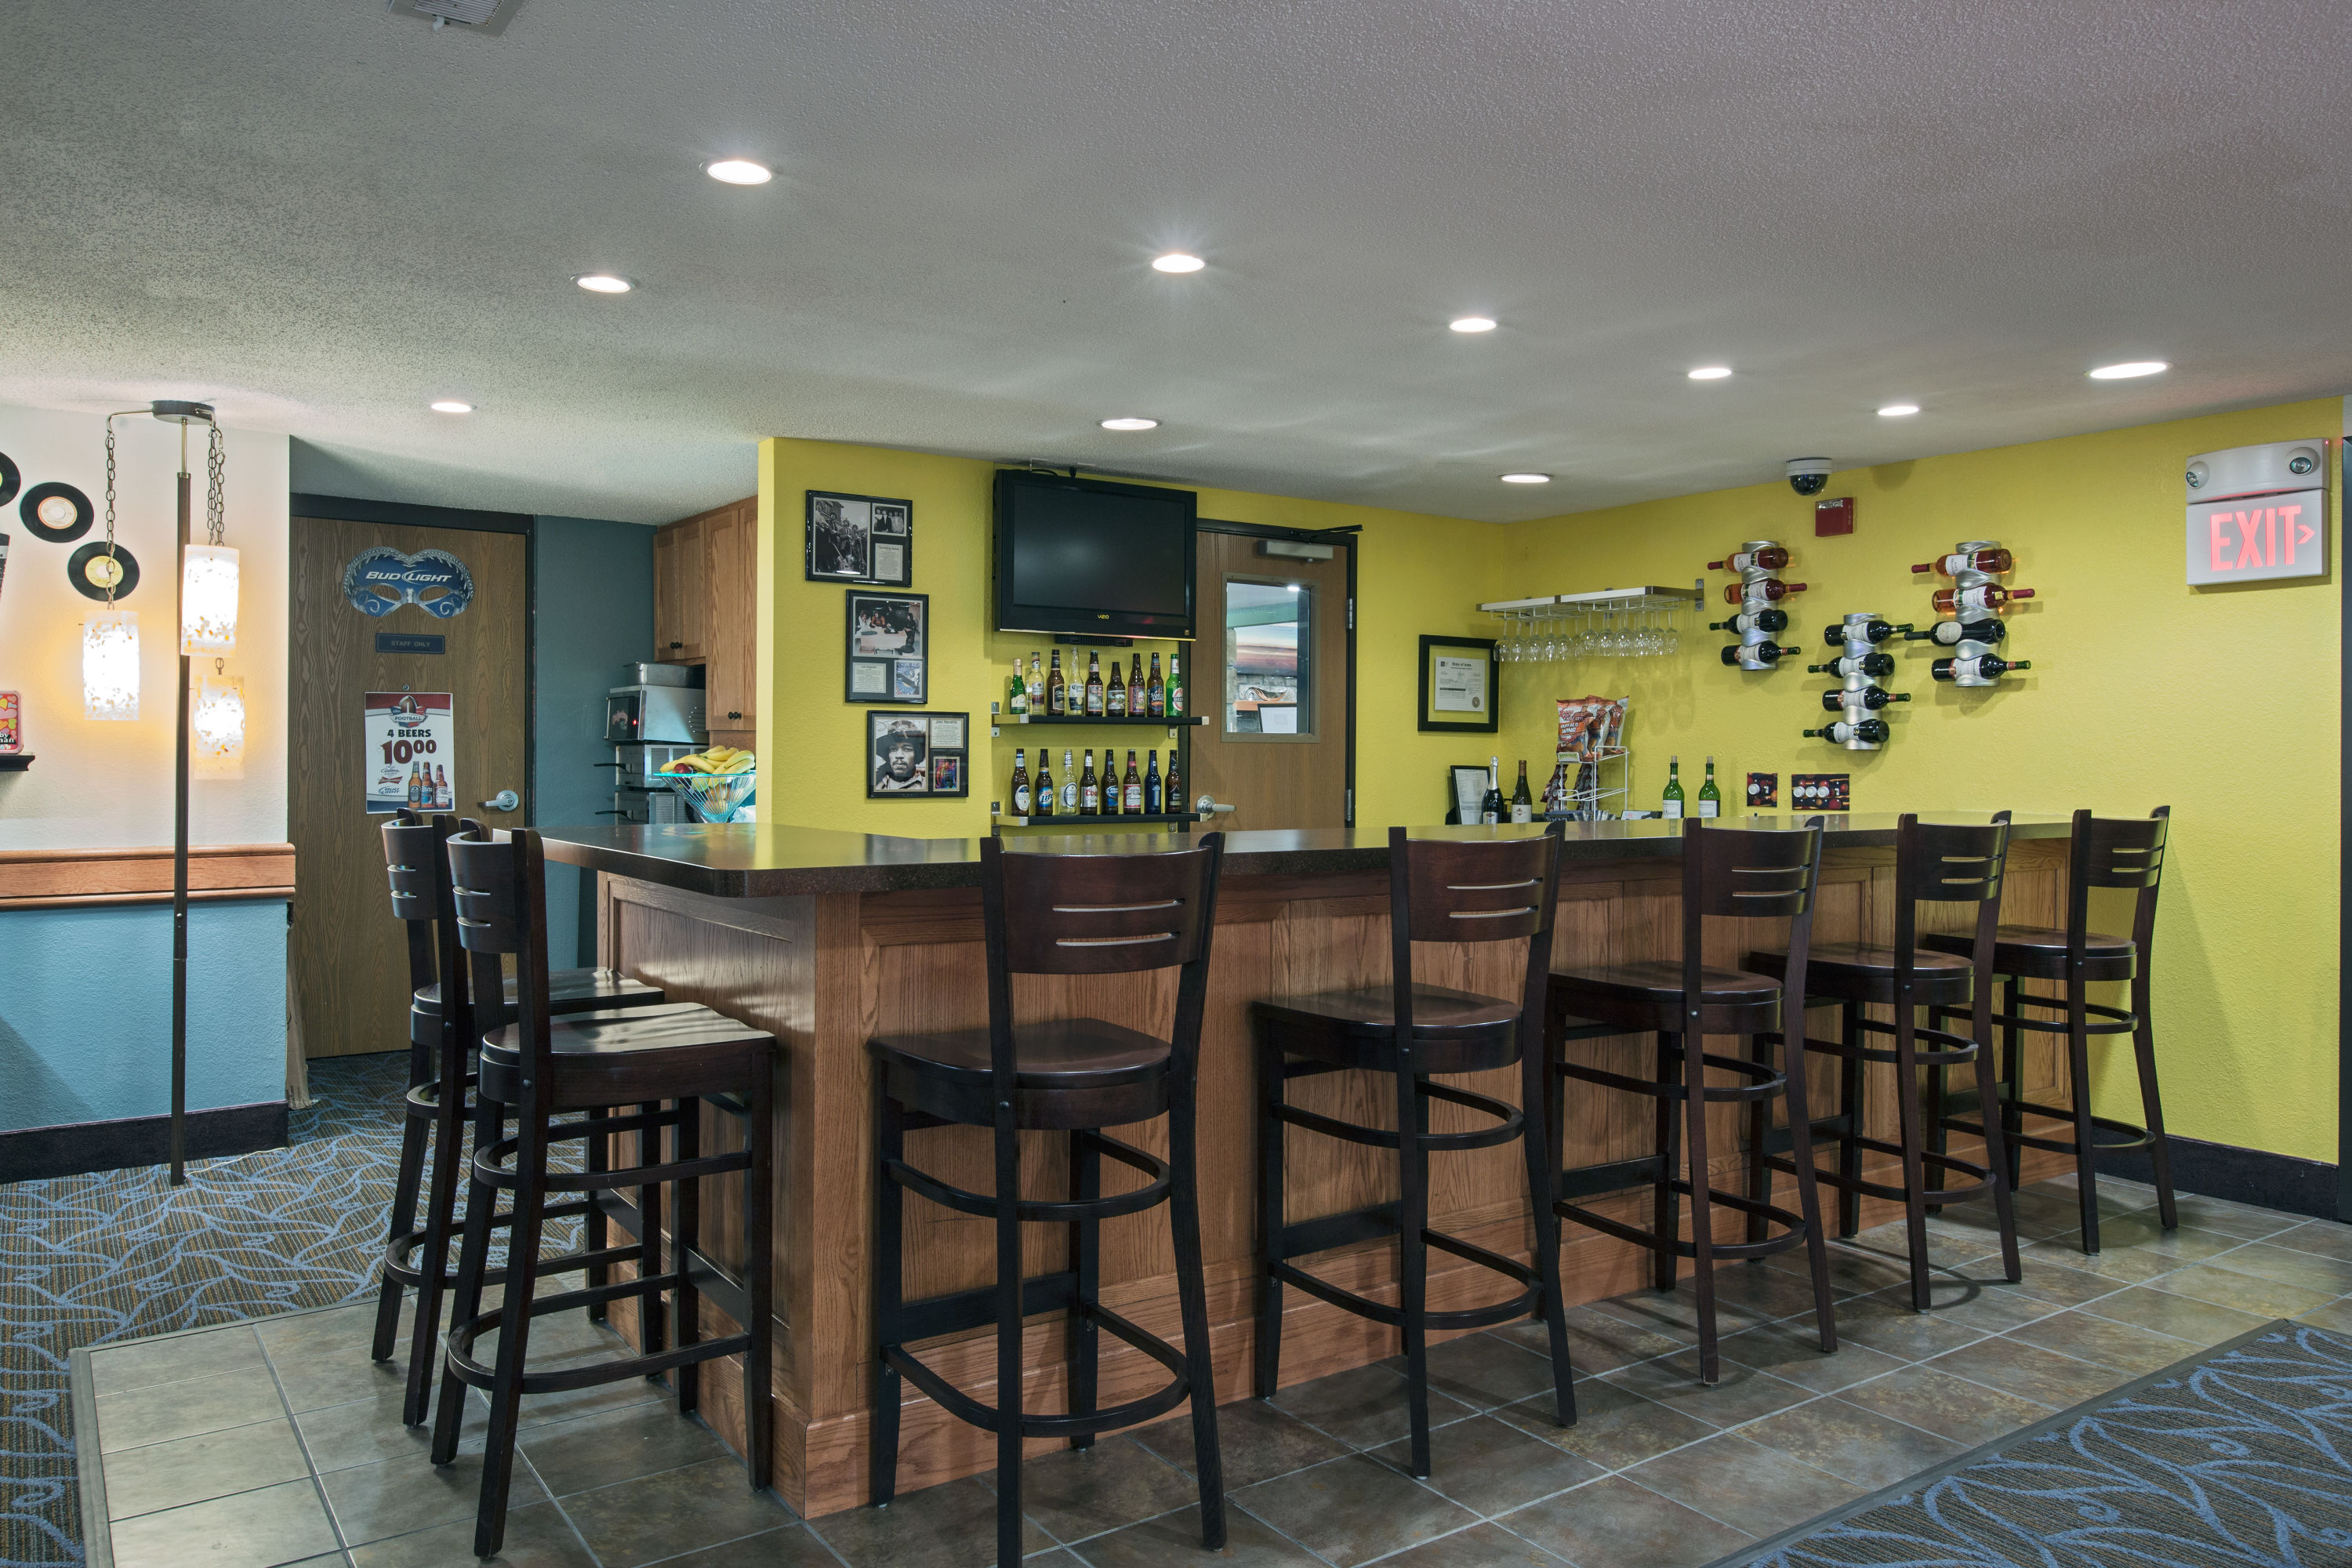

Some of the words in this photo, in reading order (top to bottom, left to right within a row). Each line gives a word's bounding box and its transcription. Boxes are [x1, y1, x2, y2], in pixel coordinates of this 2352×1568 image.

[2210, 504, 2302, 572] EXIT
[365, 571, 401, 581] BUD
[407, 572, 452, 583] LIGHT
[387, 729, 394, 738] 4
[398, 729, 431, 738] BEERS
